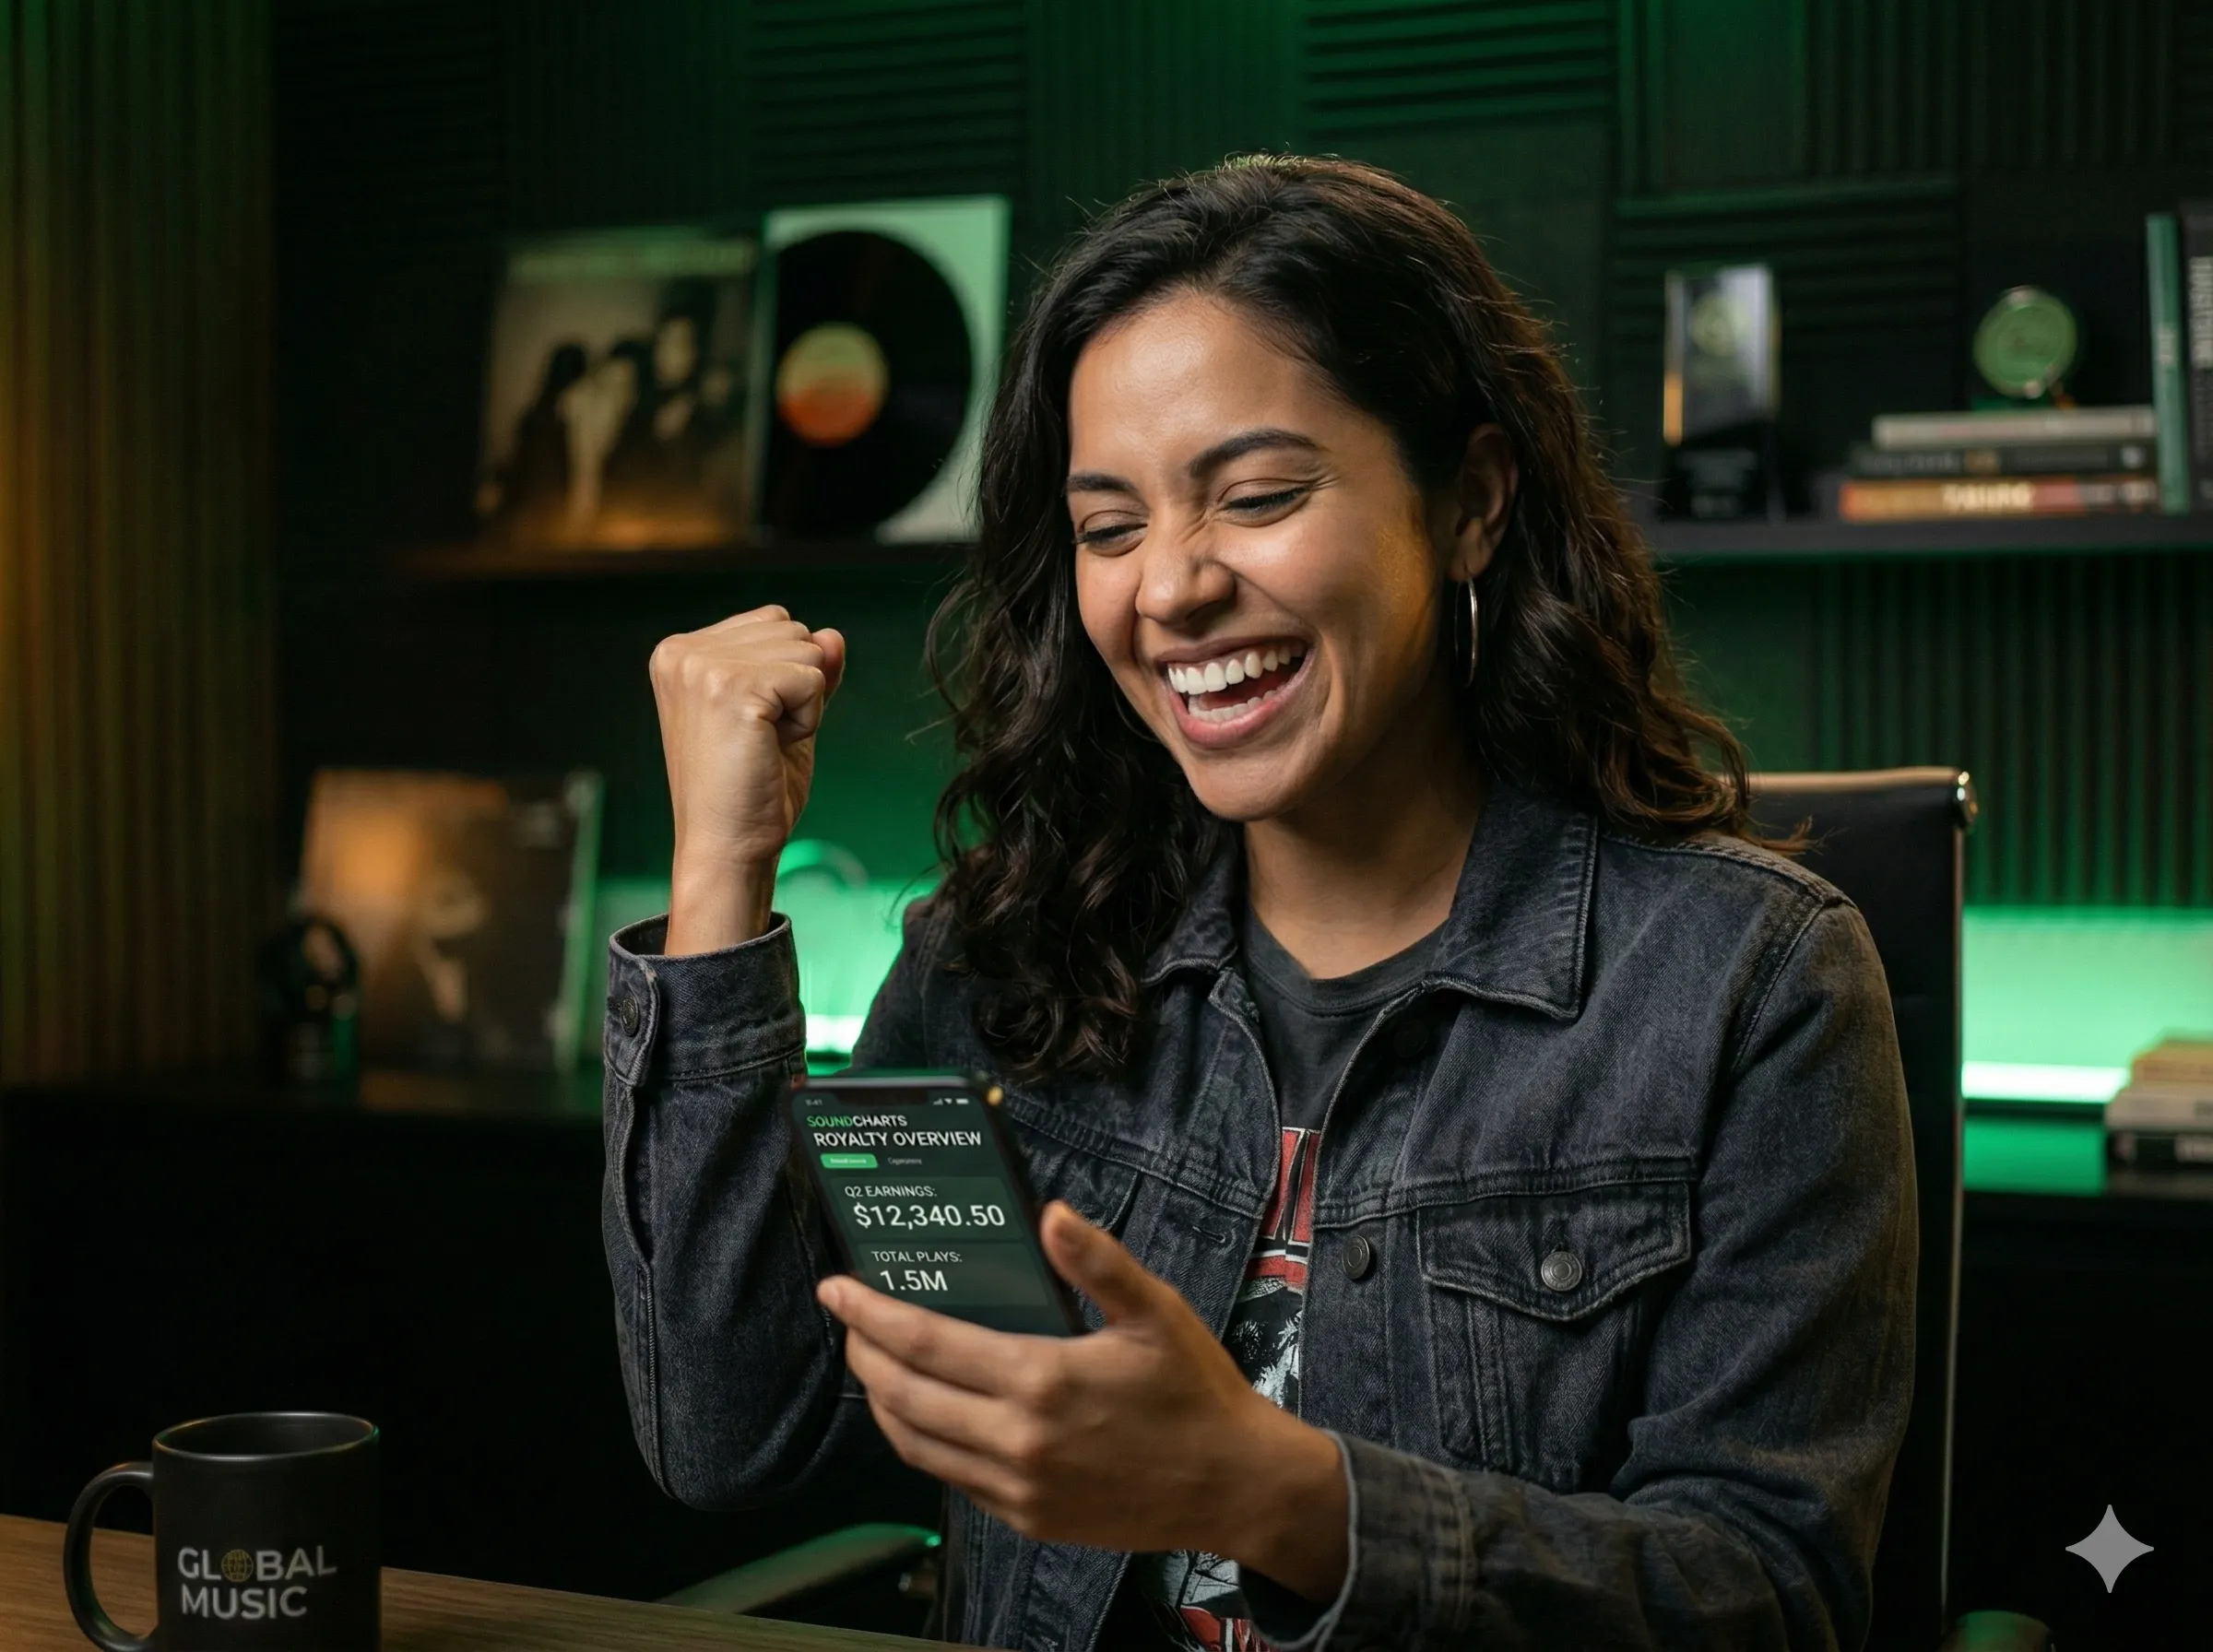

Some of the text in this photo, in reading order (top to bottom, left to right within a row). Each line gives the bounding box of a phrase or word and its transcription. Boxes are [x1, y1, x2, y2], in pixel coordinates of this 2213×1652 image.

[806, 1115, 908, 1127] SOUNDCHARTS
[813, 1131, 982, 1148] ROYALTY OVERVIEW
[845, 1186, 938, 1198] Q2 EARNINGS:
[853, 1202, 1005, 1231] $12,340.50
[871, 1251, 963, 1263] TOTAL PLAYS:
[880, 1269, 949, 1292] 1.5M
[177, 1545, 338, 1583] GLOBAL
[181, 1584, 308, 1620] MUSIC
